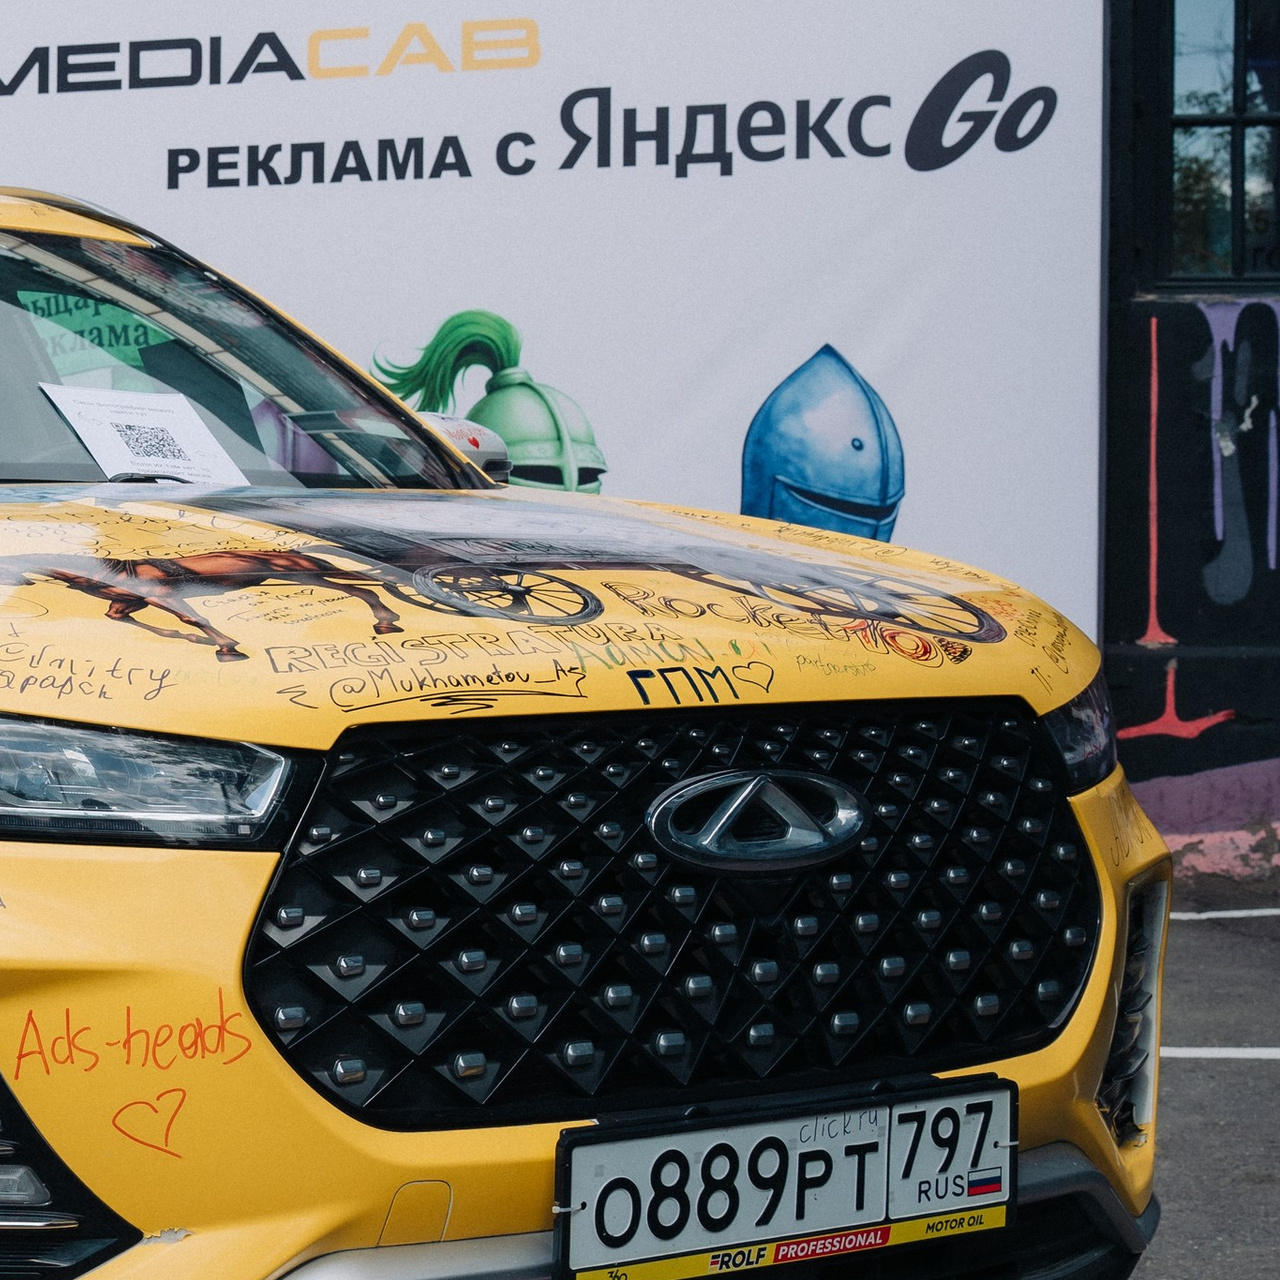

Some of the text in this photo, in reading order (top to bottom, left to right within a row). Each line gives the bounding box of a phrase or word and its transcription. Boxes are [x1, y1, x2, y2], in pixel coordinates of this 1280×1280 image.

[167, 134, 472, 190] РЕКЛАМА
[559, 86, 892, 179] Яндекс
[904, 49, 1058, 172] Go
[626, 665, 741, 706] ГПМ
[897, 1100, 994, 1180] 797
[918, 1173, 966, 1204] RUS
[718, 1246, 767, 1272] ROLF
[777, 1230, 884, 1260] PROFESSIONAL
[925, 1217, 965, 1235] MOTOR
[966, 1214, 985, 1228] OIL
